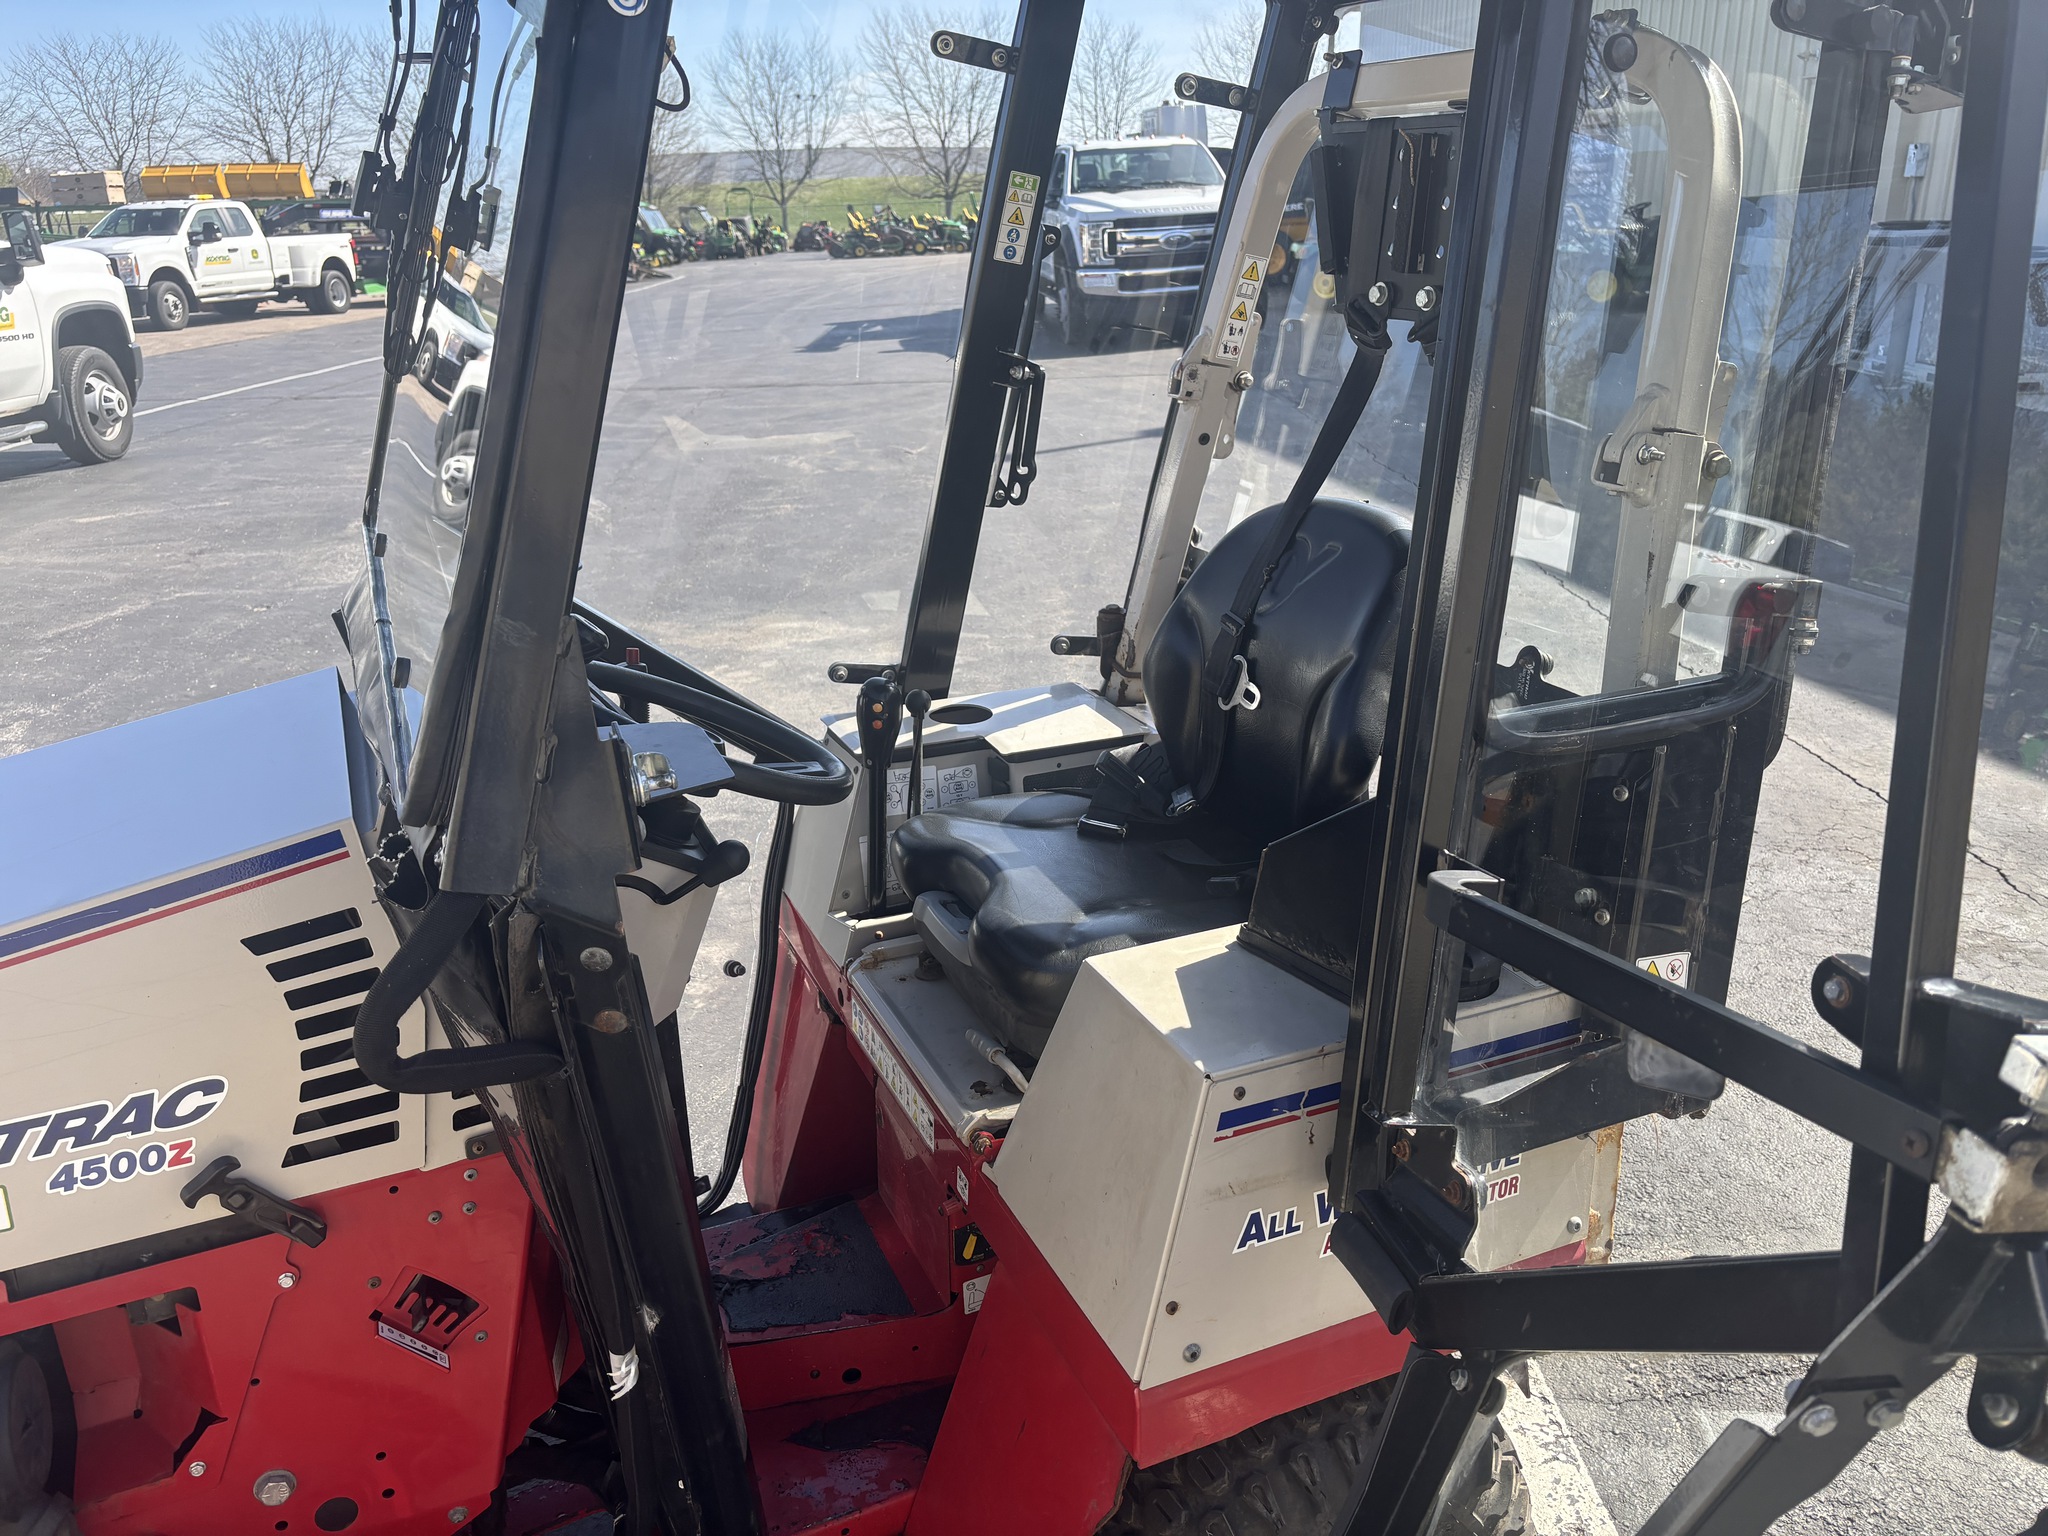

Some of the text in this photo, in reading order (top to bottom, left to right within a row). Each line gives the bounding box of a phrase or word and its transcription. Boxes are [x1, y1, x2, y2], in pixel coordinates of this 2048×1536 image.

[0, 1078, 226, 1165] TRAC
[48, 1138, 195, 1194] 4500Z
[1237, 1206, 1302, 1251] ALL
